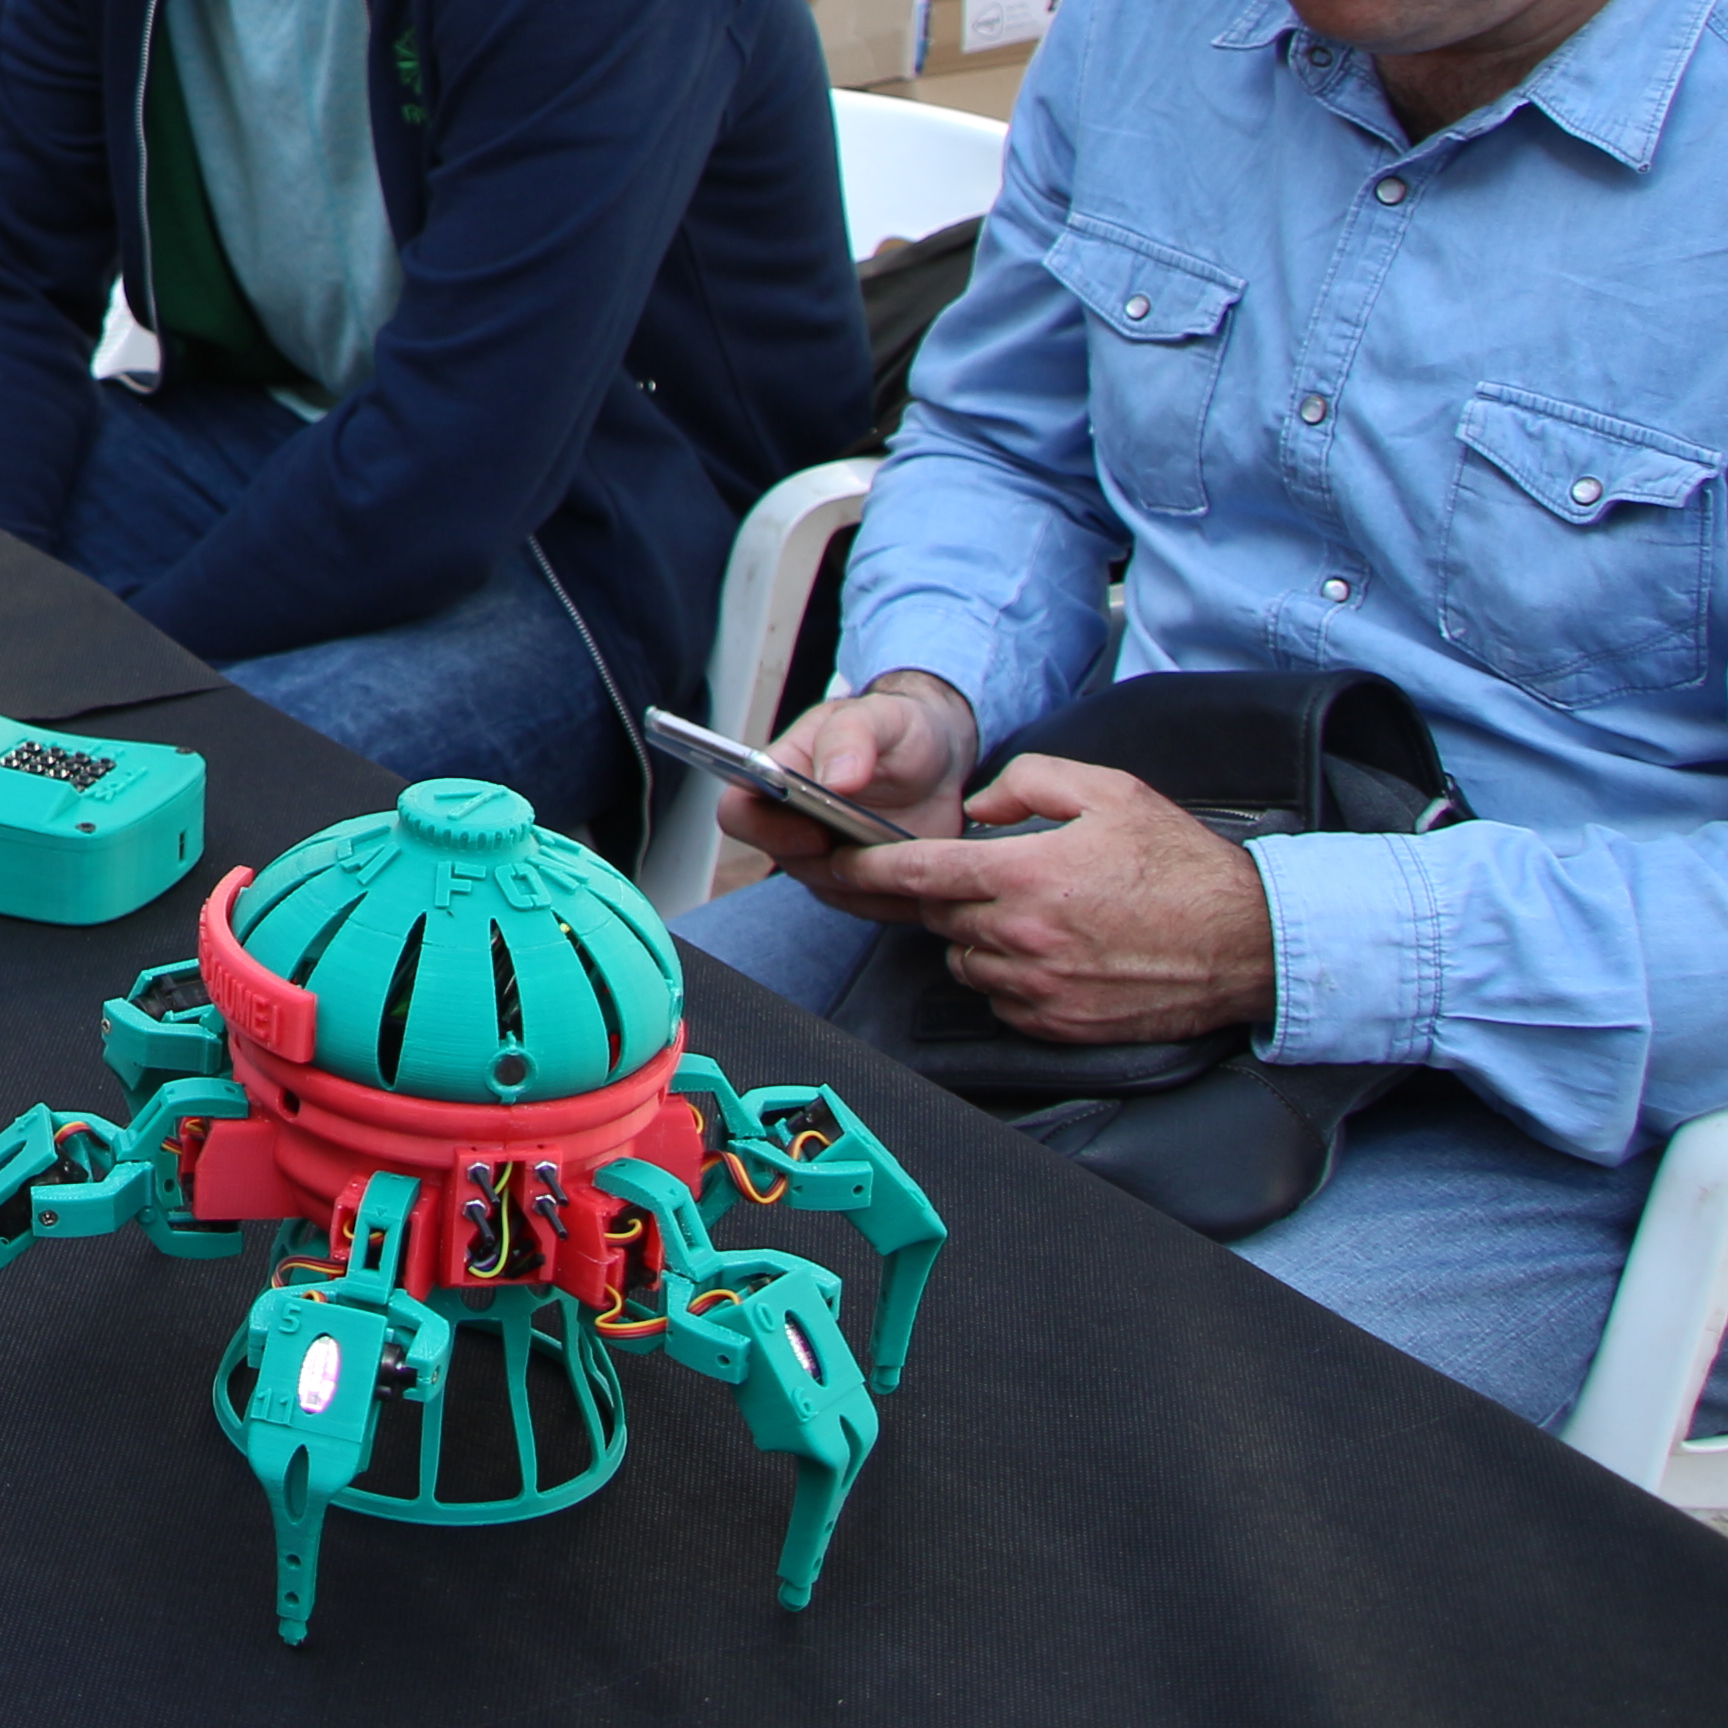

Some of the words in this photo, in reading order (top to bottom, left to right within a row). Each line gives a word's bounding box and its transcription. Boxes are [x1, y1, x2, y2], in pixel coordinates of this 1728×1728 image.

[278, 1303, 302, 1334] 5
[250, 1387, 293, 1426] 11
[792, 1387, 819, 1421] 6
